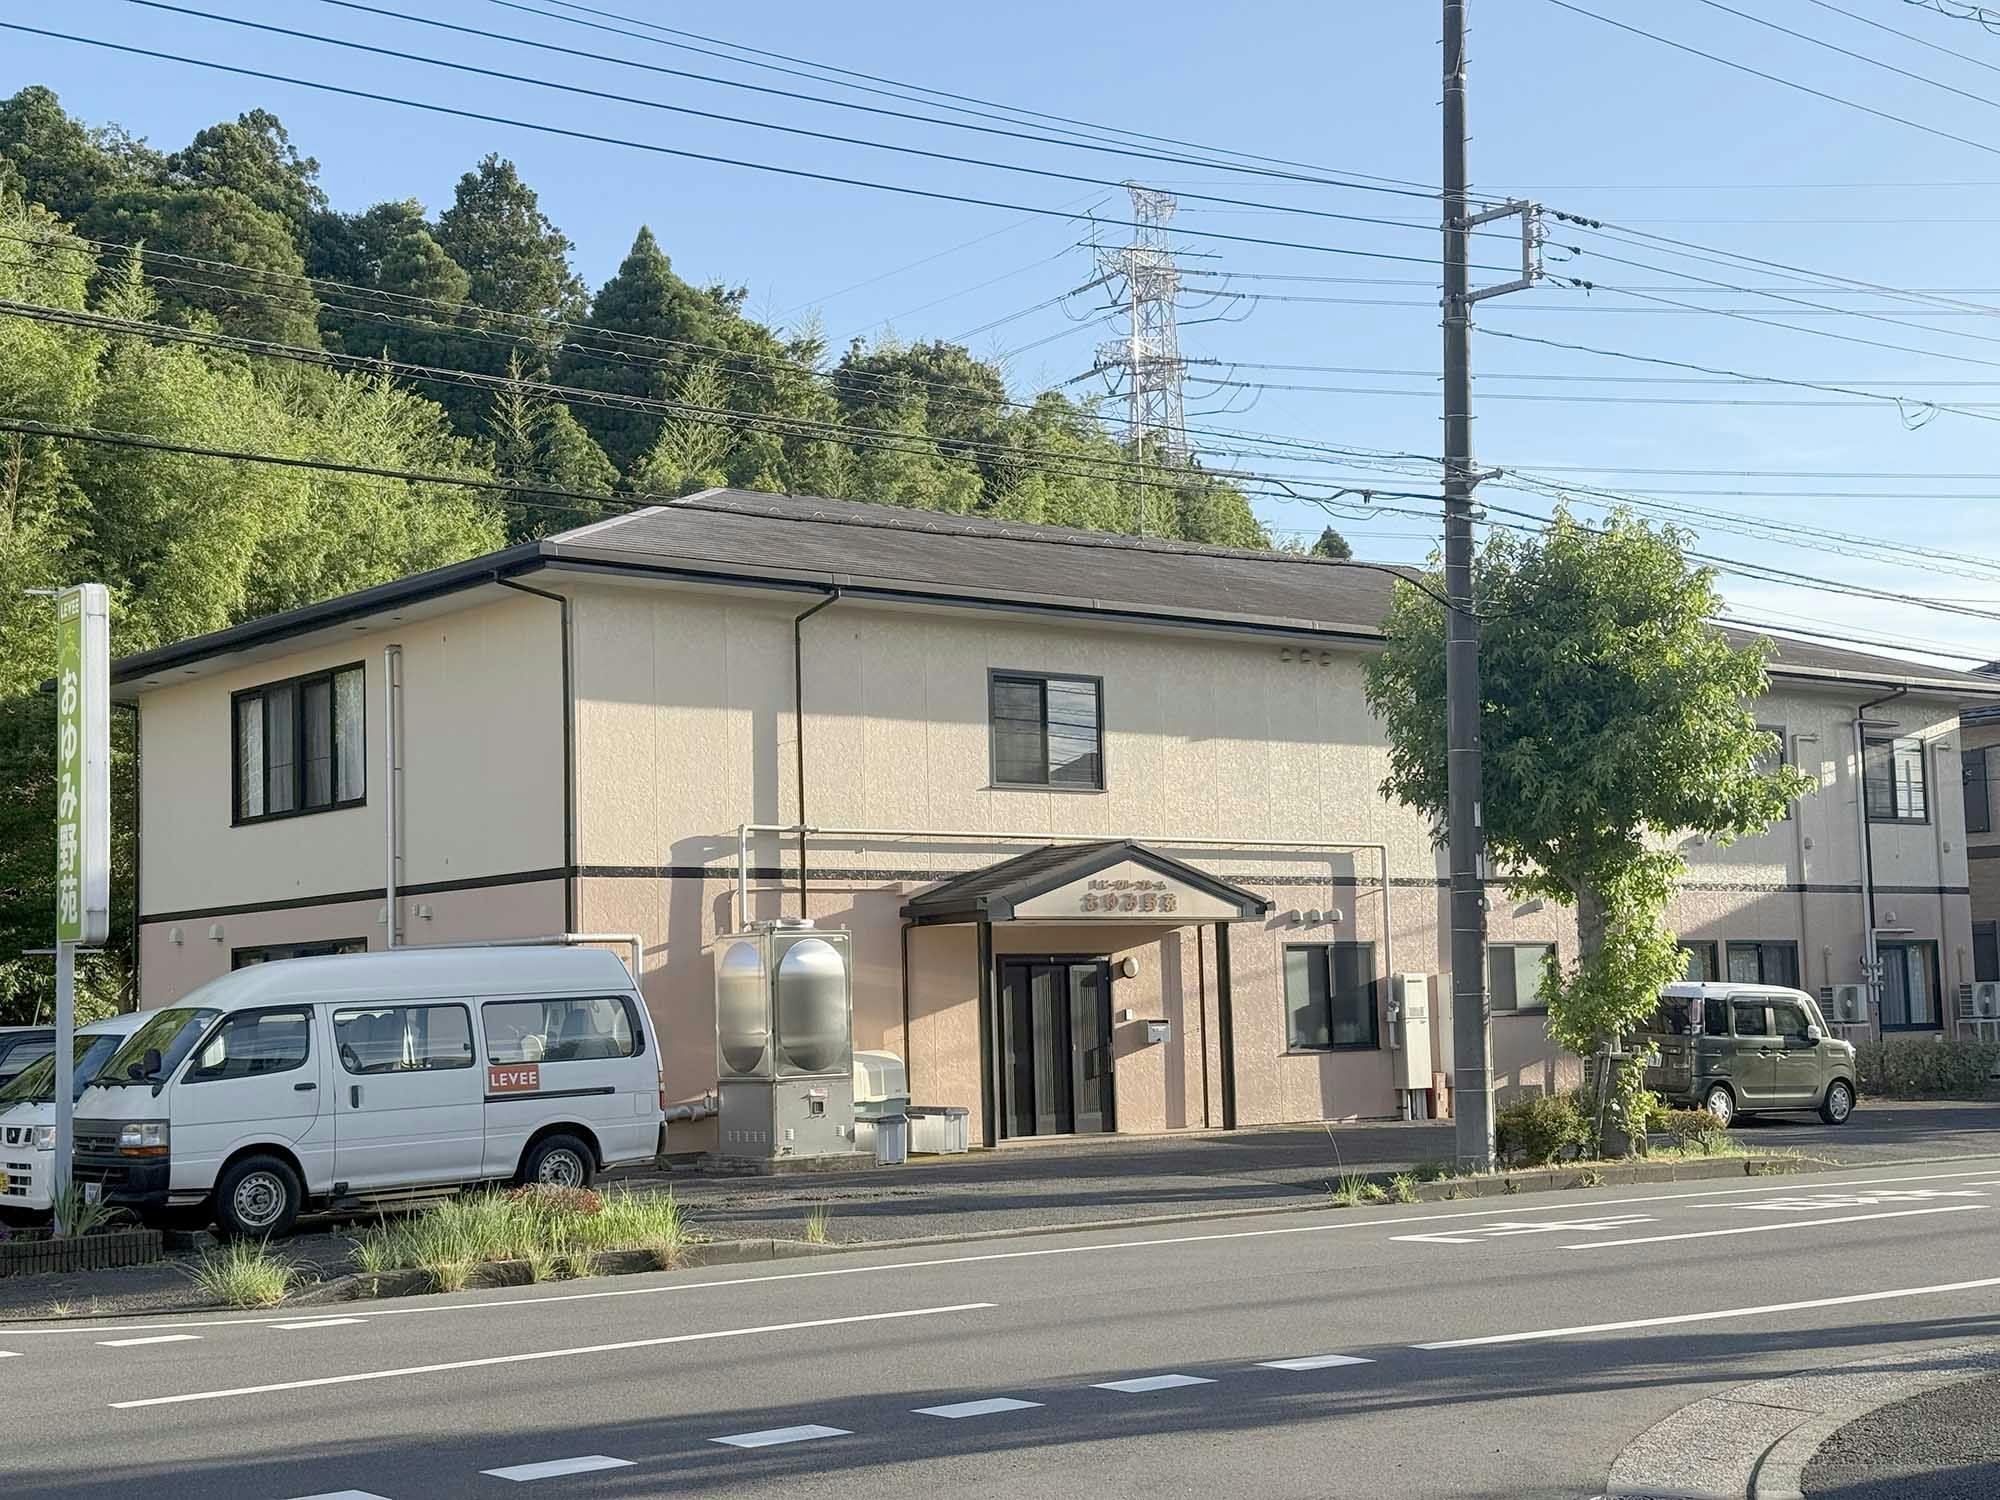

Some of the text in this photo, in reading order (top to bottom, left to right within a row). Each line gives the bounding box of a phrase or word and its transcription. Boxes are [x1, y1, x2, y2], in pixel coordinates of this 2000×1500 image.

[60, 667, 78, 925] おゆみ野苑
[491, 1071, 537, 1087] LEVEE
